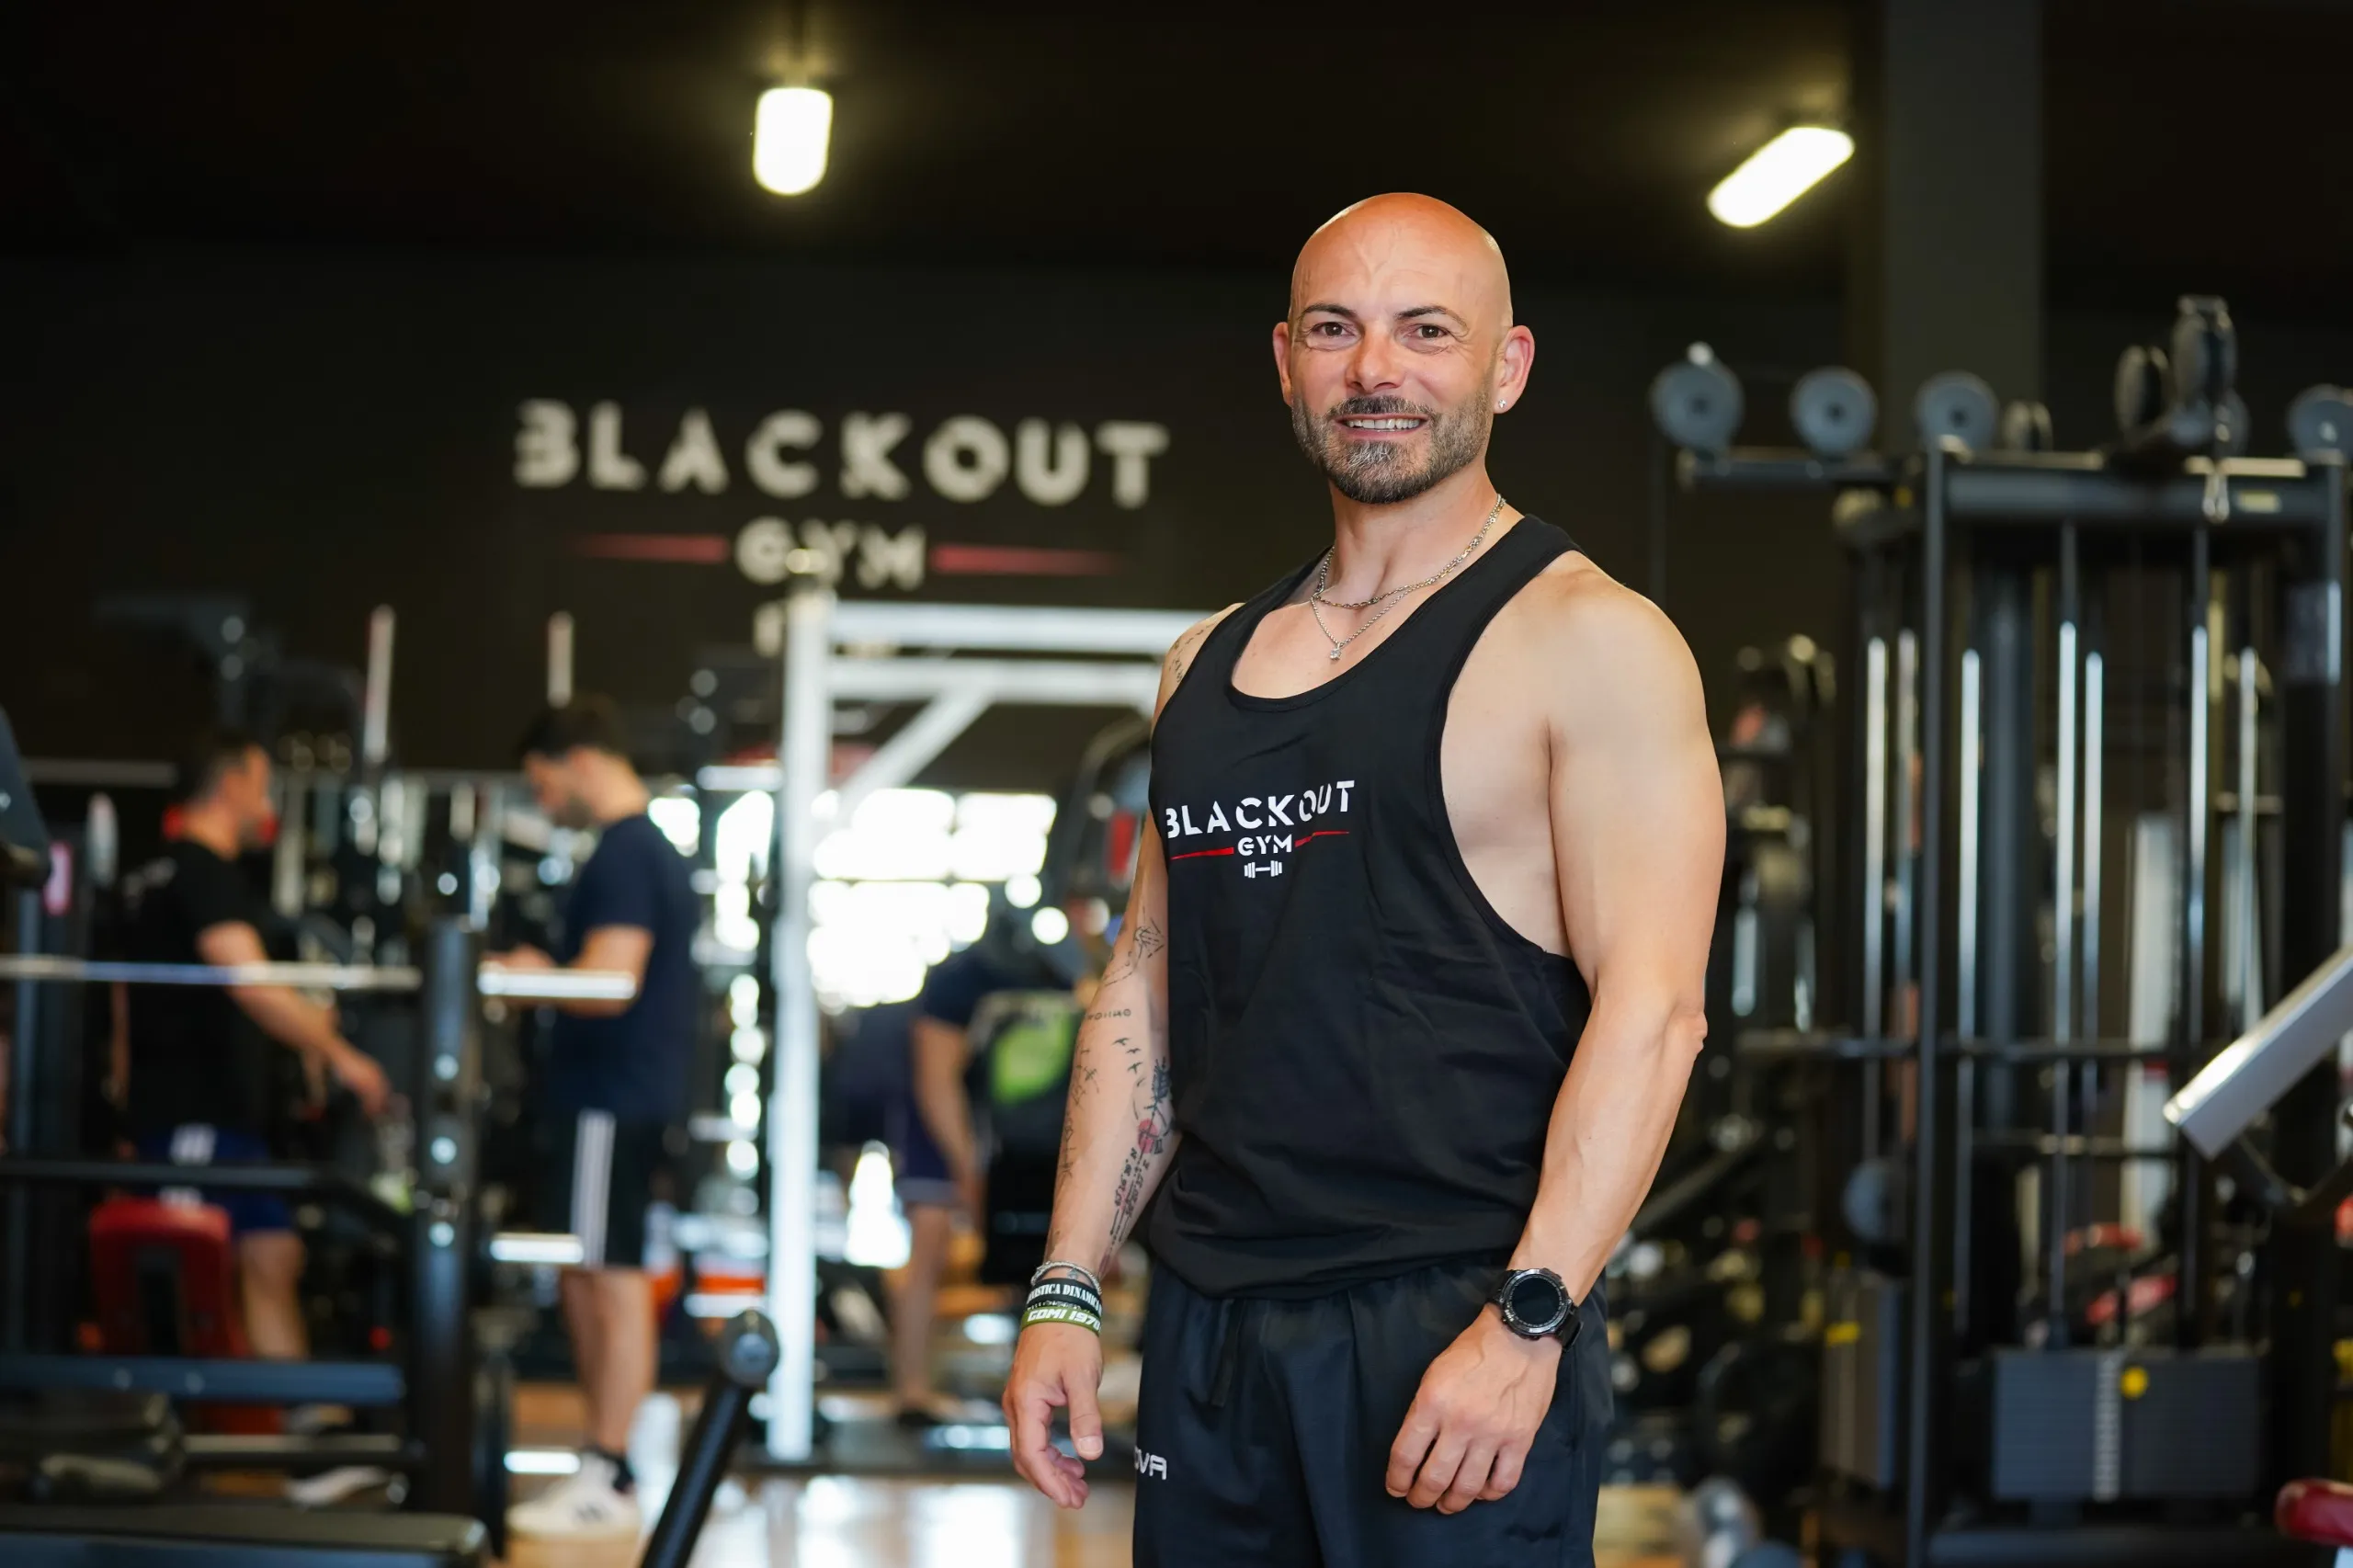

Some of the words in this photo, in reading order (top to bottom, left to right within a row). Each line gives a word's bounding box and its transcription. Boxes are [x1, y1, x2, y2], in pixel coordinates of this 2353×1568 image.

[514, 398, 1169, 508] BLACKOUT
[735, 516, 925, 590] GYM
[1165, 780, 1355, 838] BLACKOUT
[1238, 834, 1292, 856] GYM
